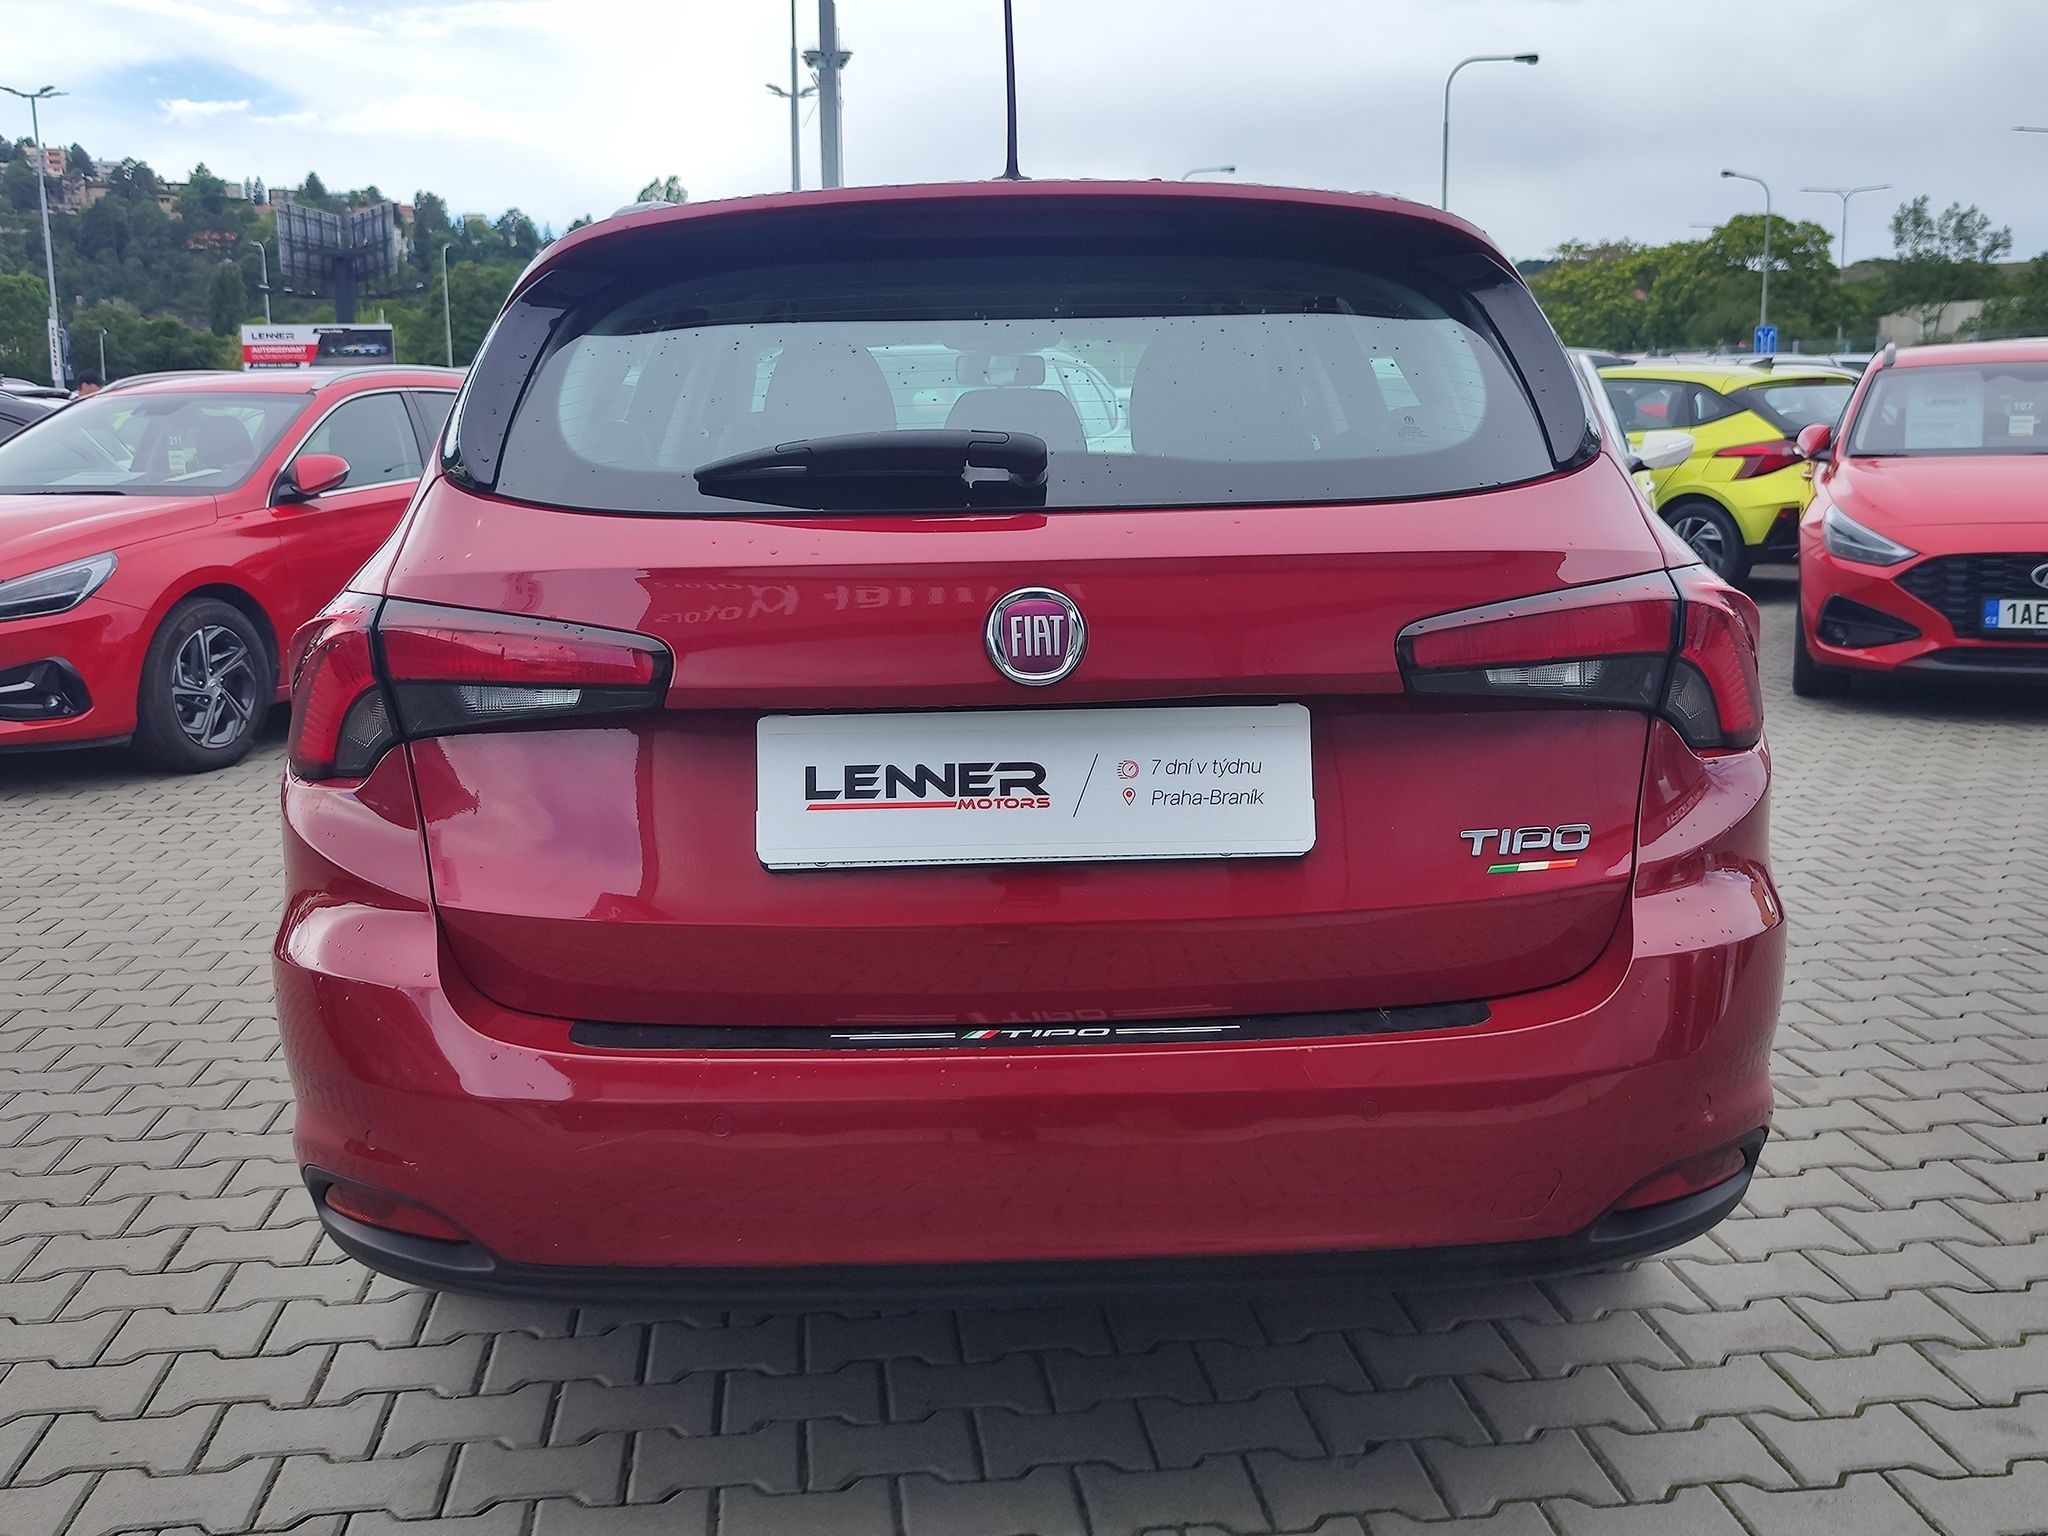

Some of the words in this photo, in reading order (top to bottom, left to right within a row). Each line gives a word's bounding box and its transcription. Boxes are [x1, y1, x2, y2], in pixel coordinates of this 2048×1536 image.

[2007, 603, 2048, 625] 1AE
[1010, 615, 1064, 657] FIAT
[1151, 759, 1162, 775] 7
[1165, 758, 1194, 775] dní
[1197, 762, 1208, 775] v
[1212, 757, 1263, 778] týdnu
[804, 762, 1051, 801] LENNER
[957, 797, 1051, 811] MOTORS
[1151, 788, 1265, 806] Praha-Braník
[1460, 823, 1592, 857] TIPO
[1000, 1028, 1111, 1039] TIPO
